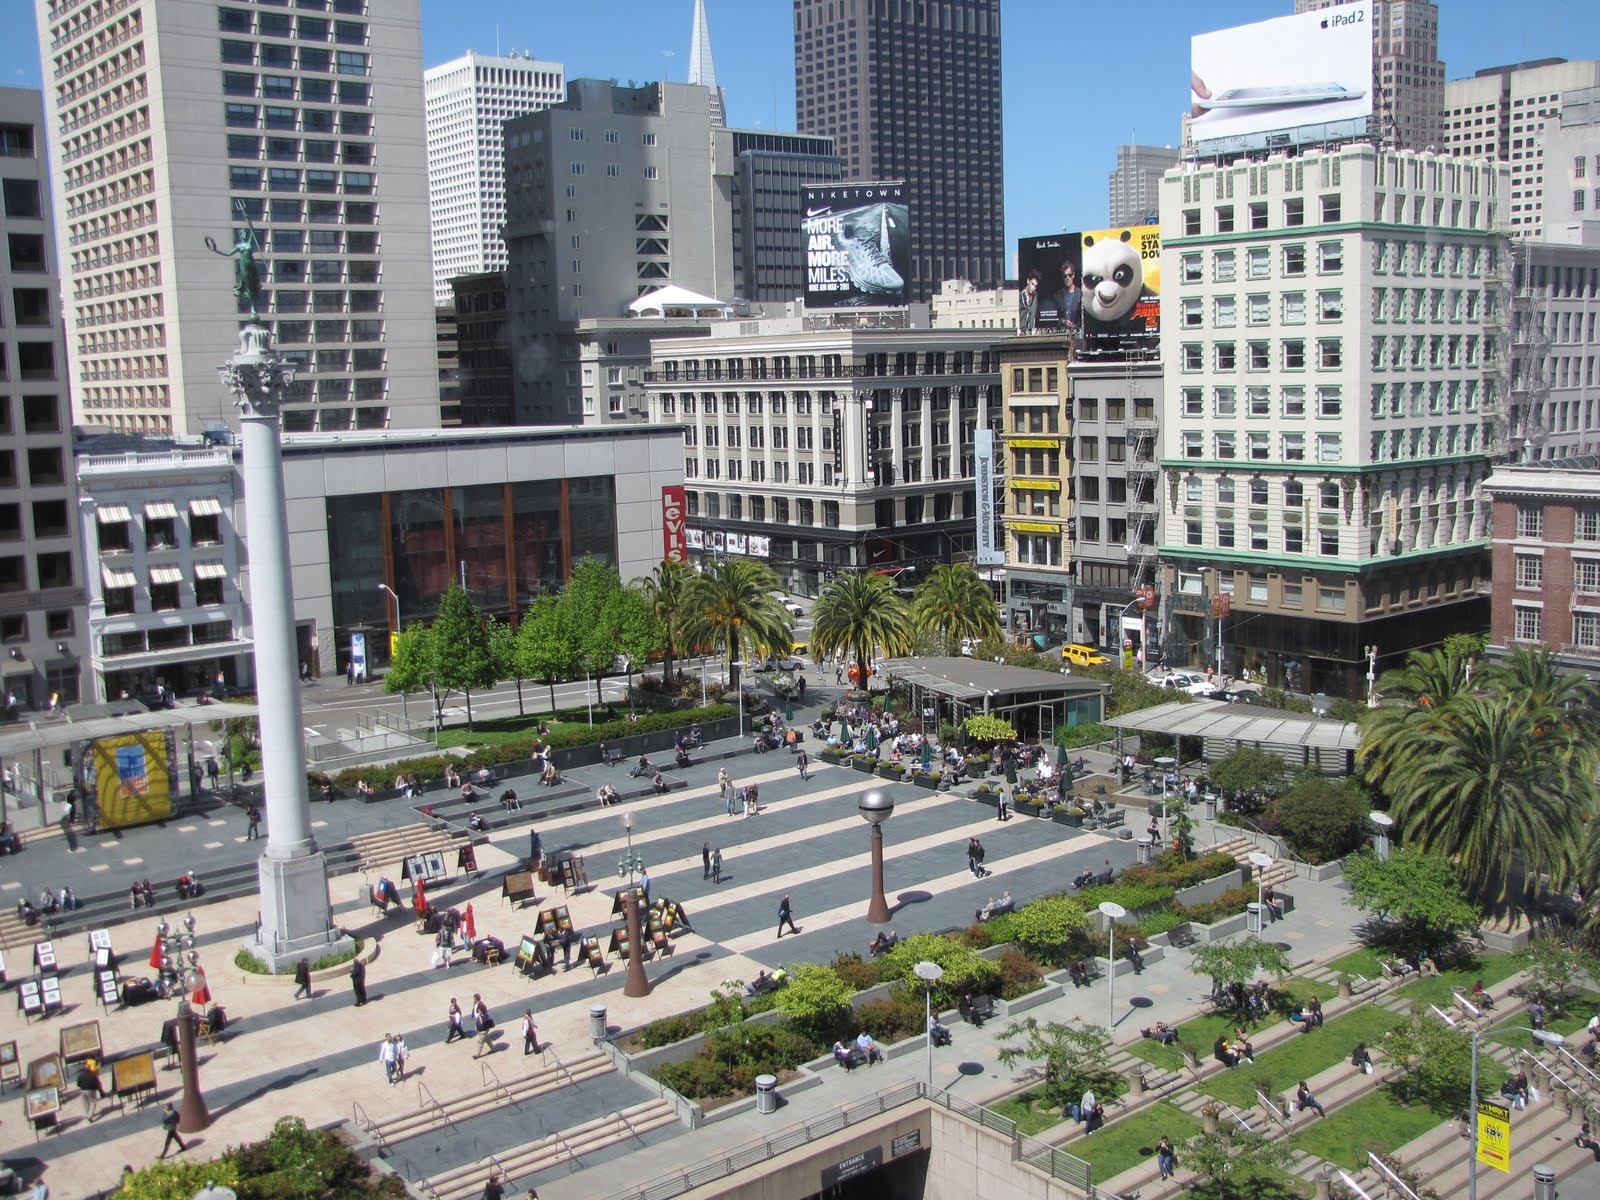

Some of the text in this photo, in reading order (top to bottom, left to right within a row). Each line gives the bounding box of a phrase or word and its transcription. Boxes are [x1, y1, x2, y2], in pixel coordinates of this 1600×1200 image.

[1331, 10, 1364, 27] iPad 2
[808, 189, 901, 199] NIKETOWN
[807, 218, 844, 234] MORE
[808, 235, 835, 250] AIR.
[808, 251, 848, 267] MORE
[808, 267, 849, 283] MILES.
[979, 455, 989, 502] JOHNSTON
[981, 511, 991, 549] MURPHY
[839, 1152, 865, 1170] ENTRANCE
